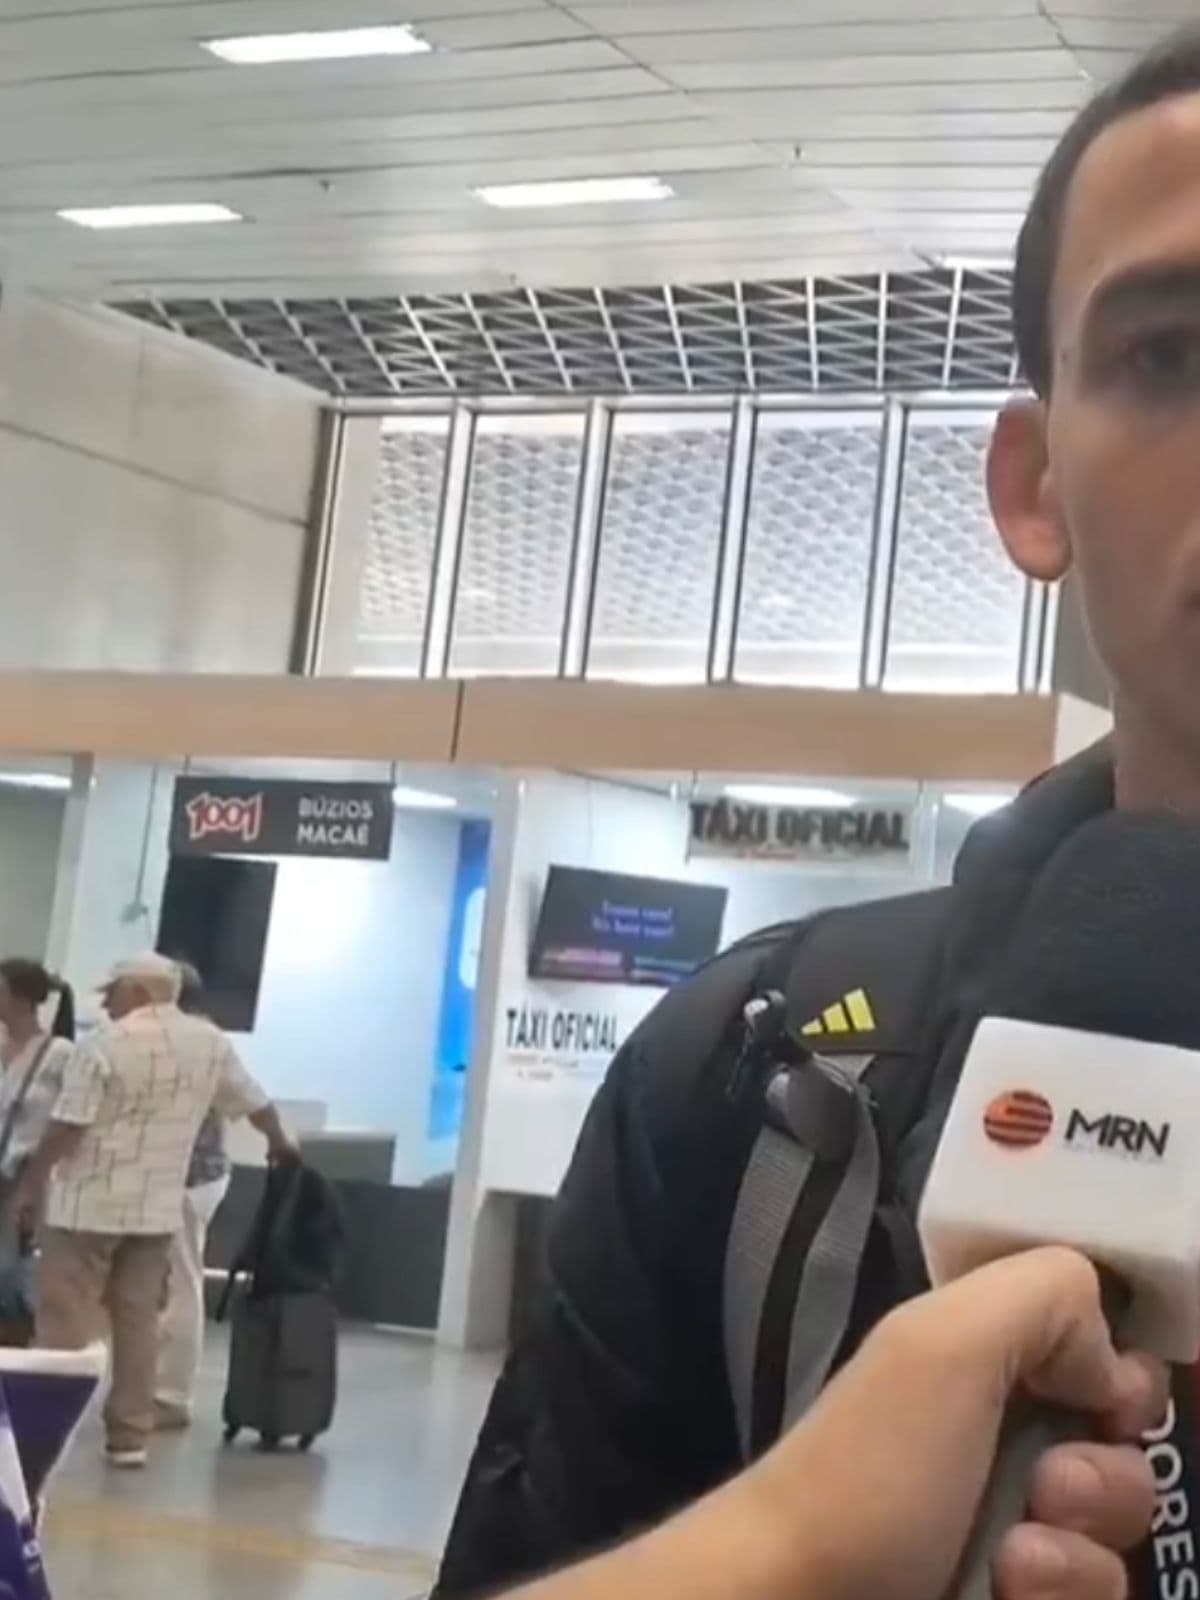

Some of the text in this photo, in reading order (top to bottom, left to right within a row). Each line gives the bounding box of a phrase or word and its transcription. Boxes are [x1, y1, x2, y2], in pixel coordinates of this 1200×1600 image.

[185, 791, 263, 842] 1001
[298, 796, 373, 820] BÚZIOS
[775, 808, 910, 852] OFICIAL
[297, 822, 369, 846] MACAÉ
[505, 1001, 617, 1051] TÁXI OFICIAL
[1063, 1107, 1171, 1158] MRN
